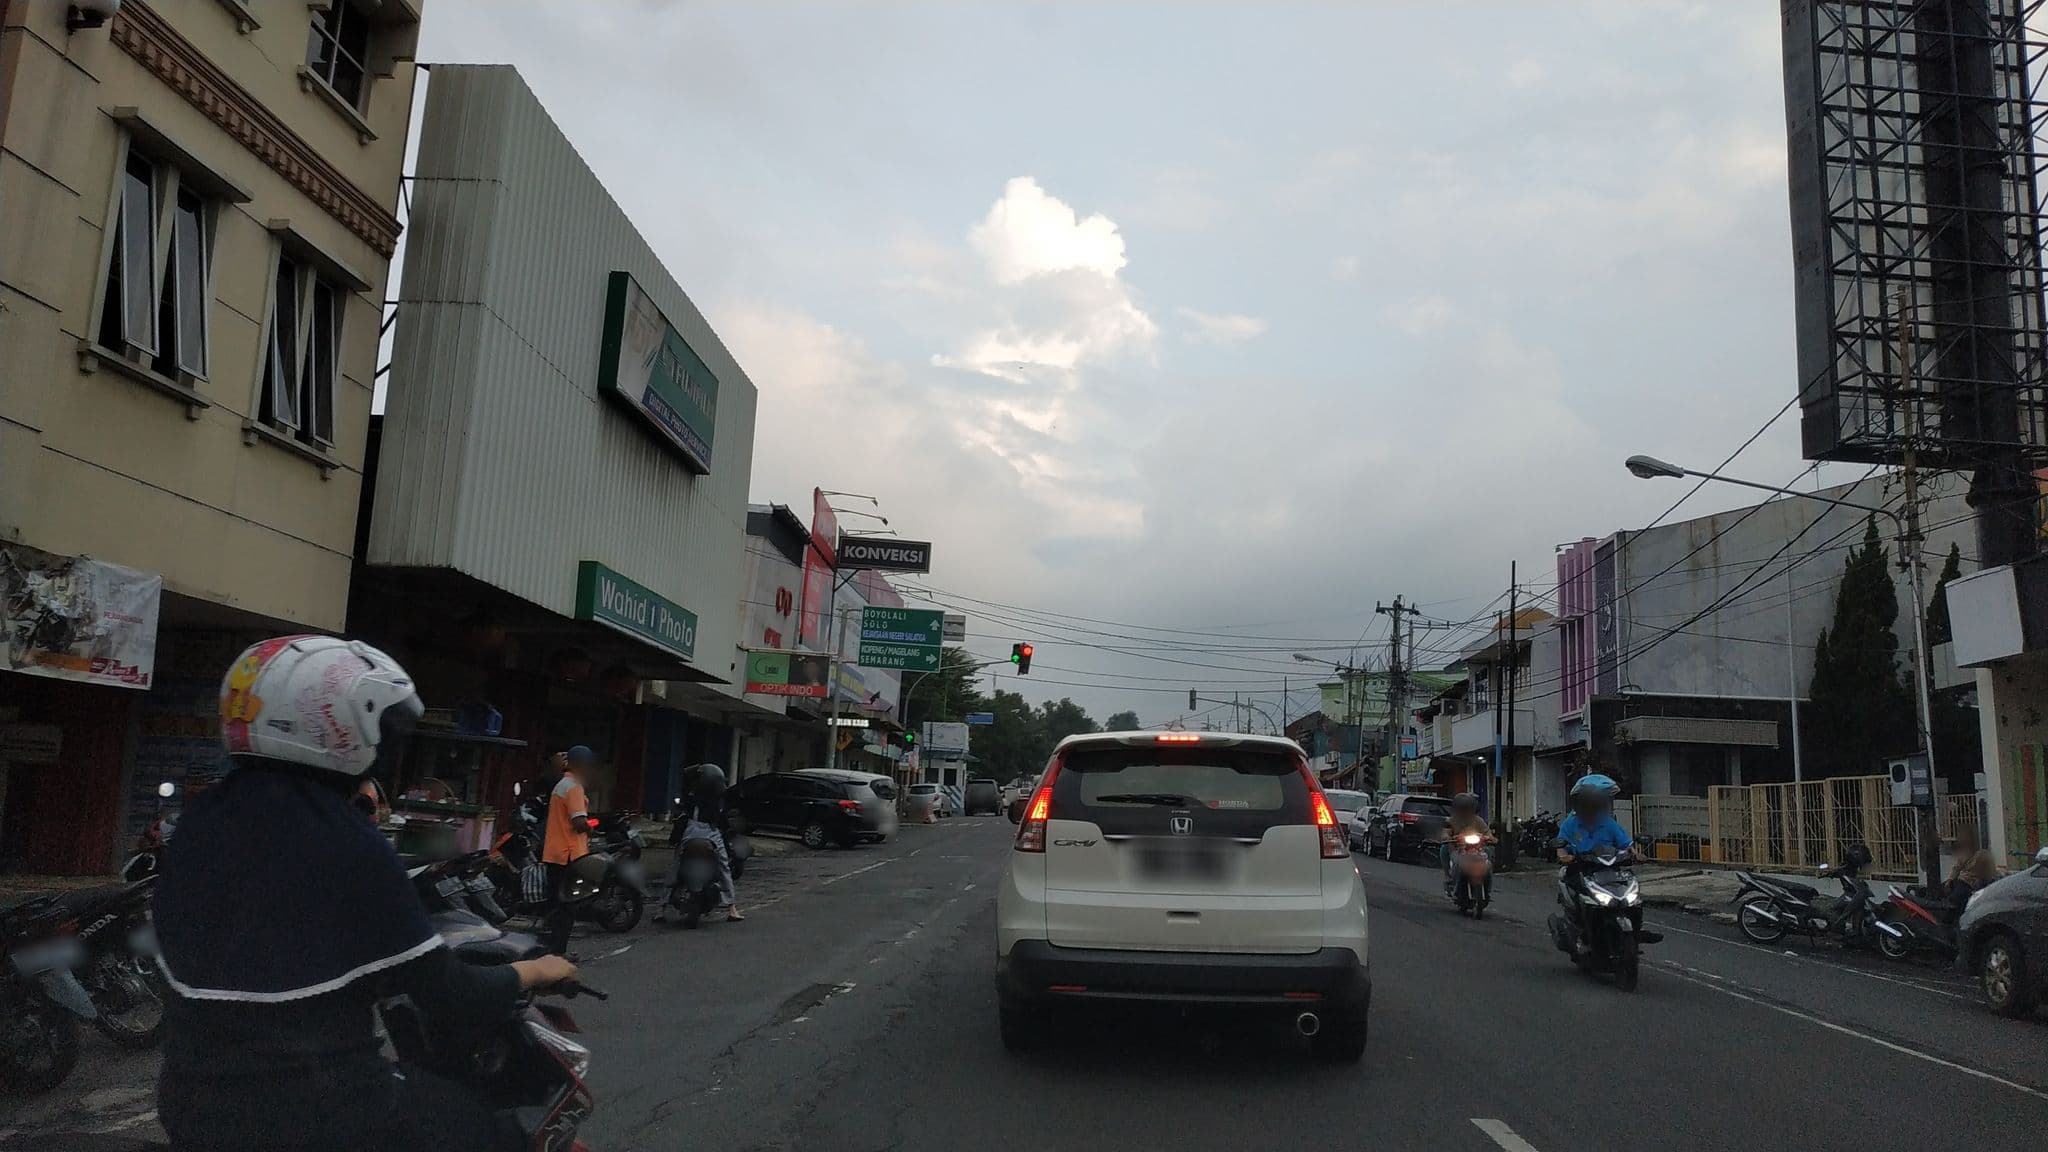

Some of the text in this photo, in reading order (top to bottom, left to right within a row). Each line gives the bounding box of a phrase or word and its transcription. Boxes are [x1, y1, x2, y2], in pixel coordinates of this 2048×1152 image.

[844, 545, 923, 564] KONVEKSI
[601, 576, 647, 625] Wahid
[659, 606, 693, 648] Photo
[864, 609, 907, 620] BOYOLALI
[863, 620, 888, 629] SOLO
[861, 645, 920, 657] KOPENG/MAGELANG
[860, 655, 905, 666] SEMARANG
[760, 683, 814, 695] OPTIK INDO
[78, 912, 119, 942] ONDA
